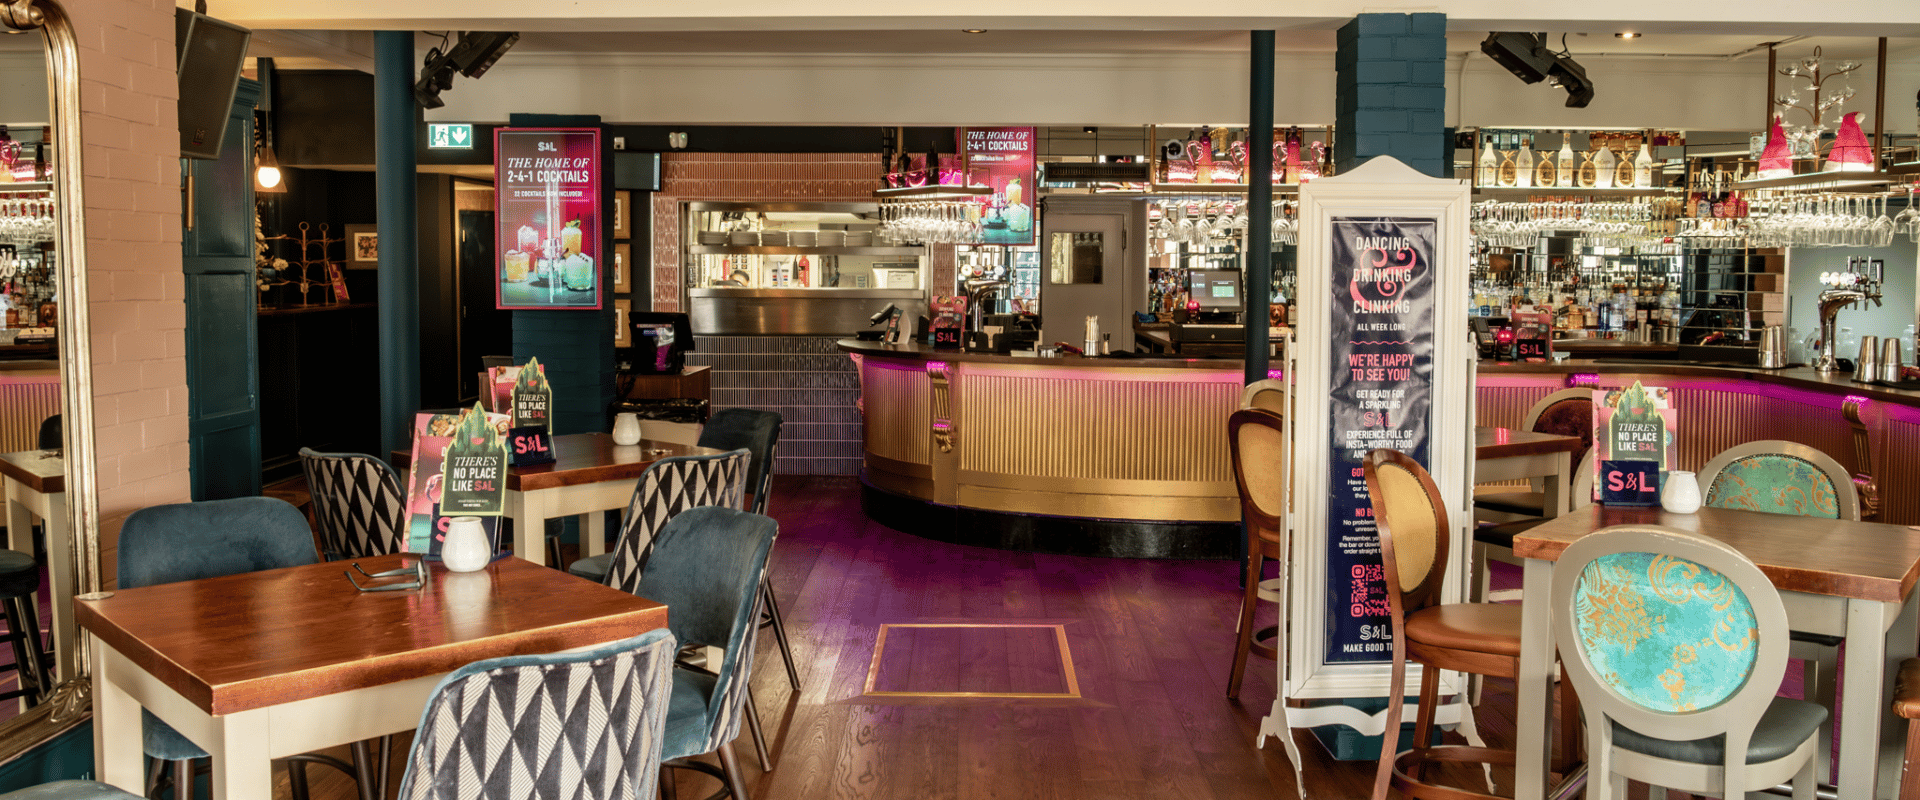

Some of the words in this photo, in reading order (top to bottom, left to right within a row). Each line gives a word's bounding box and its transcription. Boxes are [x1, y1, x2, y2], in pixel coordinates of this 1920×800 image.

[967, 131, 985, 139] THE
[987, 131, 1014, 139] HOME
[1016, 131, 1029, 139] OF
[967, 141, 985, 150] 2-4-1
[988, 141, 1028, 150] COCKTAILS
[508, 158, 532, 168] THE
[535, 158, 571, 168] HOME
[573, 158, 590, 168] OF
[508, 170, 533, 182] 2-4-1
[537, 170, 589, 182] COCKTAILS
[1356, 236, 1410, 250] DANCING
[1353, 268, 1412, 282] DRINKING
[1353, 300, 1410, 314] CLINKING
[1356, 323, 1369, 331] ALL
[1371, 323, 1388, 331] WEEK
[1390, 323, 1406, 331] LONG
[937, 332, 957, 342] S&L
[1520, 344, 1544, 355] S&L
[1349, 354, 1380, 367] WE'RE
[1382, 354, 1415, 367] HAPPY
[1351, 369, 1364, 381] TO
[1366, 369, 1385, 381] SEE
[1387, 369, 1410, 381] YOU!
[1356, 390, 1368, 399] GET
[1369, 390, 1391, 399] READY
[1392, 390, 1405, 399] FOR
[519, 402, 527, 410] NO
[528, 402, 546, 410] PLACE
[1359, 401, 1364, 409] A
[1365, 401, 1401, 409] SPARKLING
[519, 411, 532, 419] LIKE
[1363, 412, 1396, 427] S&L
[1618, 423, 1658, 431] THERE'S
[1346, 431, 1385, 439] EXPERIENCE
[1386, 431, 1403, 439] FULL
[1404, 430, 1413, 438] OF
[1618, 432, 1630, 441] NO
[1632, 432, 1658, 441] PLACE
[515, 434, 548, 454] S&L
[1346, 440, 1394, 449] INSTA-WORTHY
[1396, 440, 1413, 449] FOOD
[1618, 442, 1637, 451] LIKE
[1638, 442, 1658, 452] S&L
[455, 456, 498, 467] THERE'S
[453, 467, 466, 479] NO
[469, 467, 497, 479] PLACE
[452, 480, 473, 491] LIKE
[474, 480, 495, 491] S&L
[1607, 470, 1656, 493] S&L
[1355, 508, 1366, 517] NO
[1360, 624, 1392, 640] S&L
[1343, 644, 1363, 653] MAKE
[1365, 643, 1384, 652] GOOD
